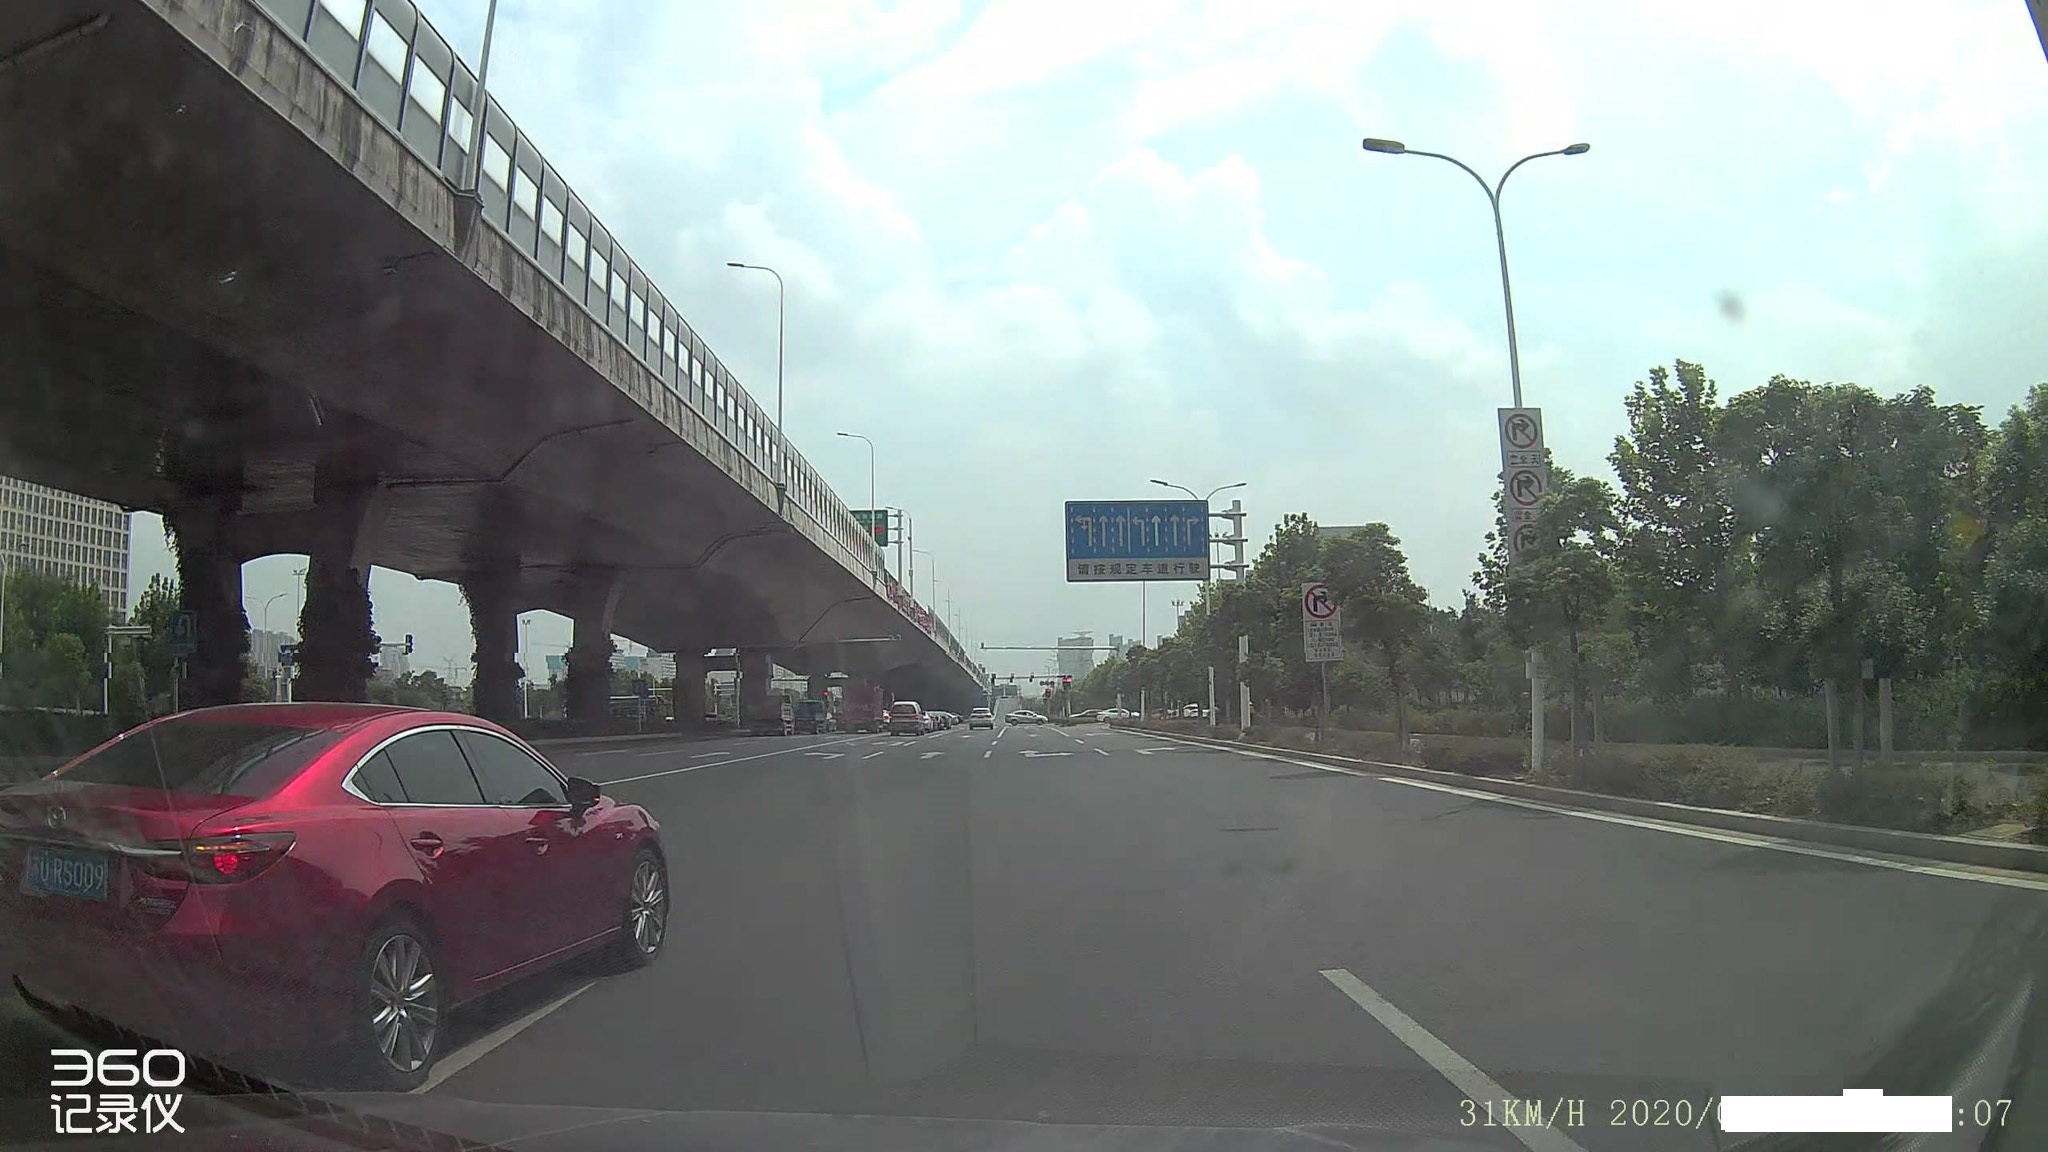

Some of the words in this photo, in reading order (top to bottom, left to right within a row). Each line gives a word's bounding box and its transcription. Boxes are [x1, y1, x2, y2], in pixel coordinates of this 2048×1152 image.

[1077, 563, 1200, 575] 请按规定车道行驶
